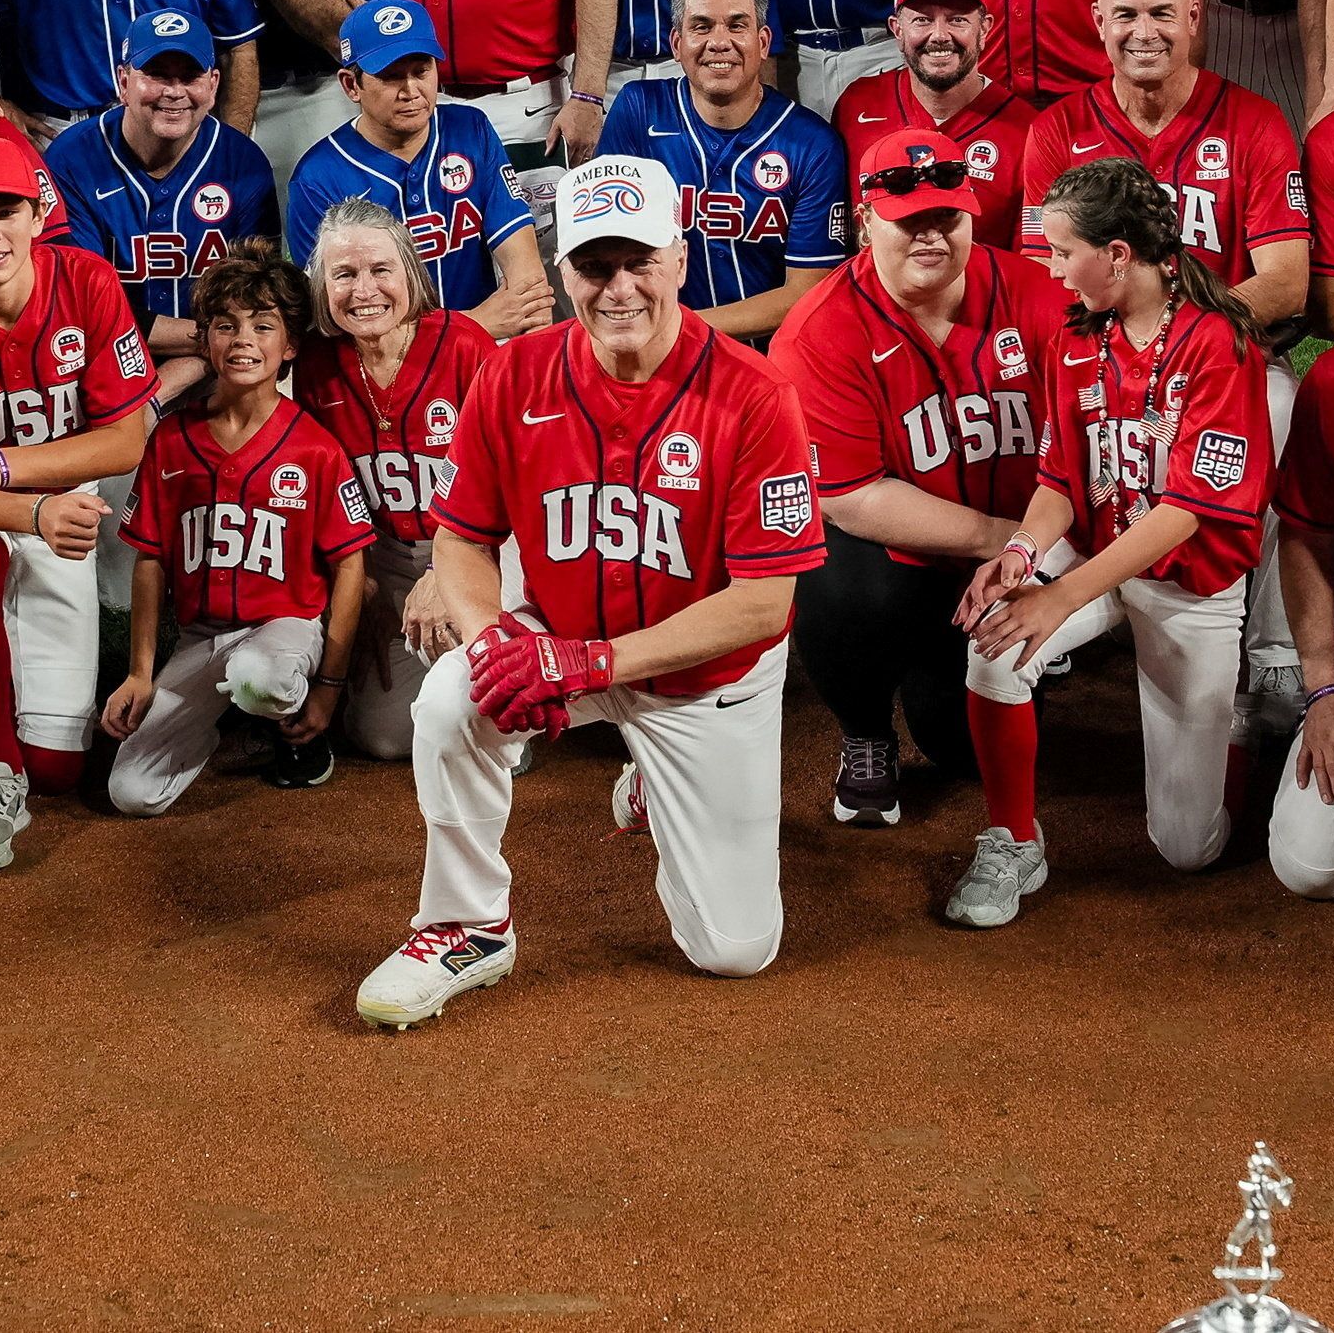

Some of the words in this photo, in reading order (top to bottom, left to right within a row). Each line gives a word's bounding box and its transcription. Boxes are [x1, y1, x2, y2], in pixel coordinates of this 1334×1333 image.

[573, 165, 642, 187] AMERICA
[572, 178, 646, 224] 250
[112, 227, 230, 284] USA
[901, 389, 1038, 473] USA
[1204, 435, 1246, 457] USA
[1196, 456, 1245, 484] 250
[659, 476, 699, 490] 6-14-17
[767, 480, 807, 500] USA
[270, 498, 307, 510] 6-14-17
[765, 504, 812, 525] 250
[179, 499, 289, 584] USA
[542, 483, 695, 581] USA
